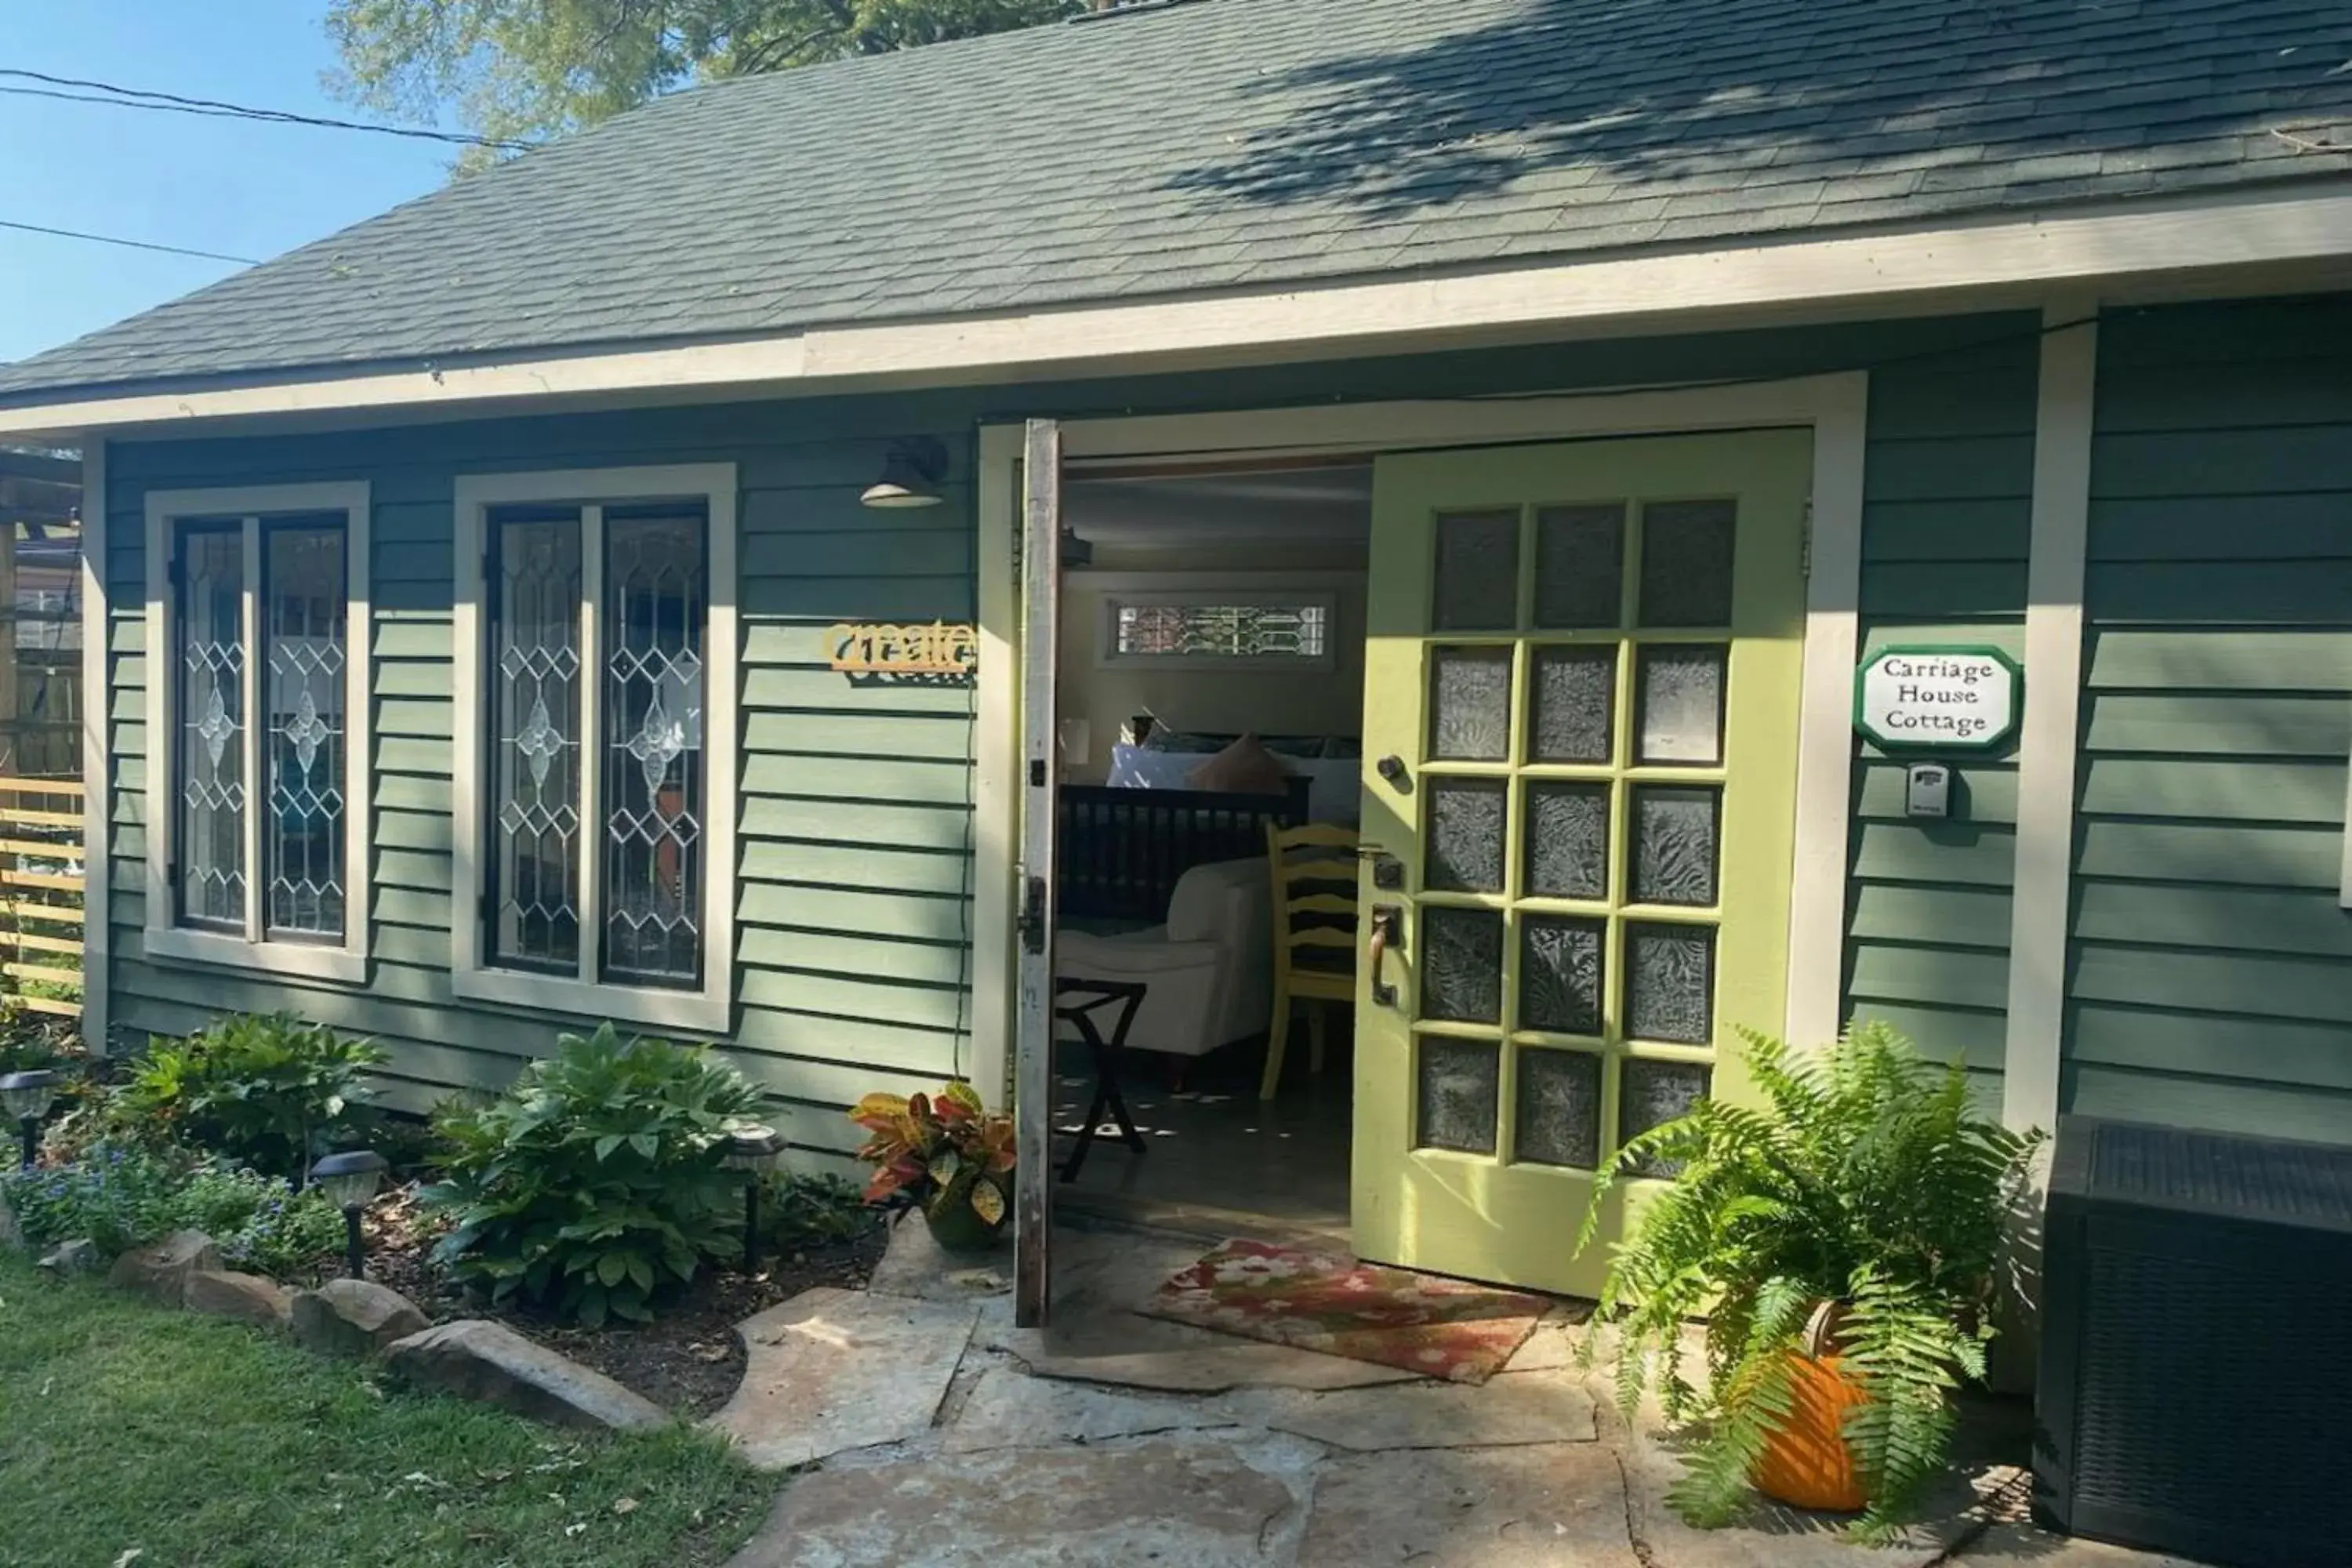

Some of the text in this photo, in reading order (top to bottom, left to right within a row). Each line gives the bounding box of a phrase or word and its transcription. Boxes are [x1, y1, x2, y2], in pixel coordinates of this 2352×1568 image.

[1884, 659, 1994, 684] Carriage
[1897, 684, 1979, 703] House
[1886, 710, 1987, 736] Cottage
